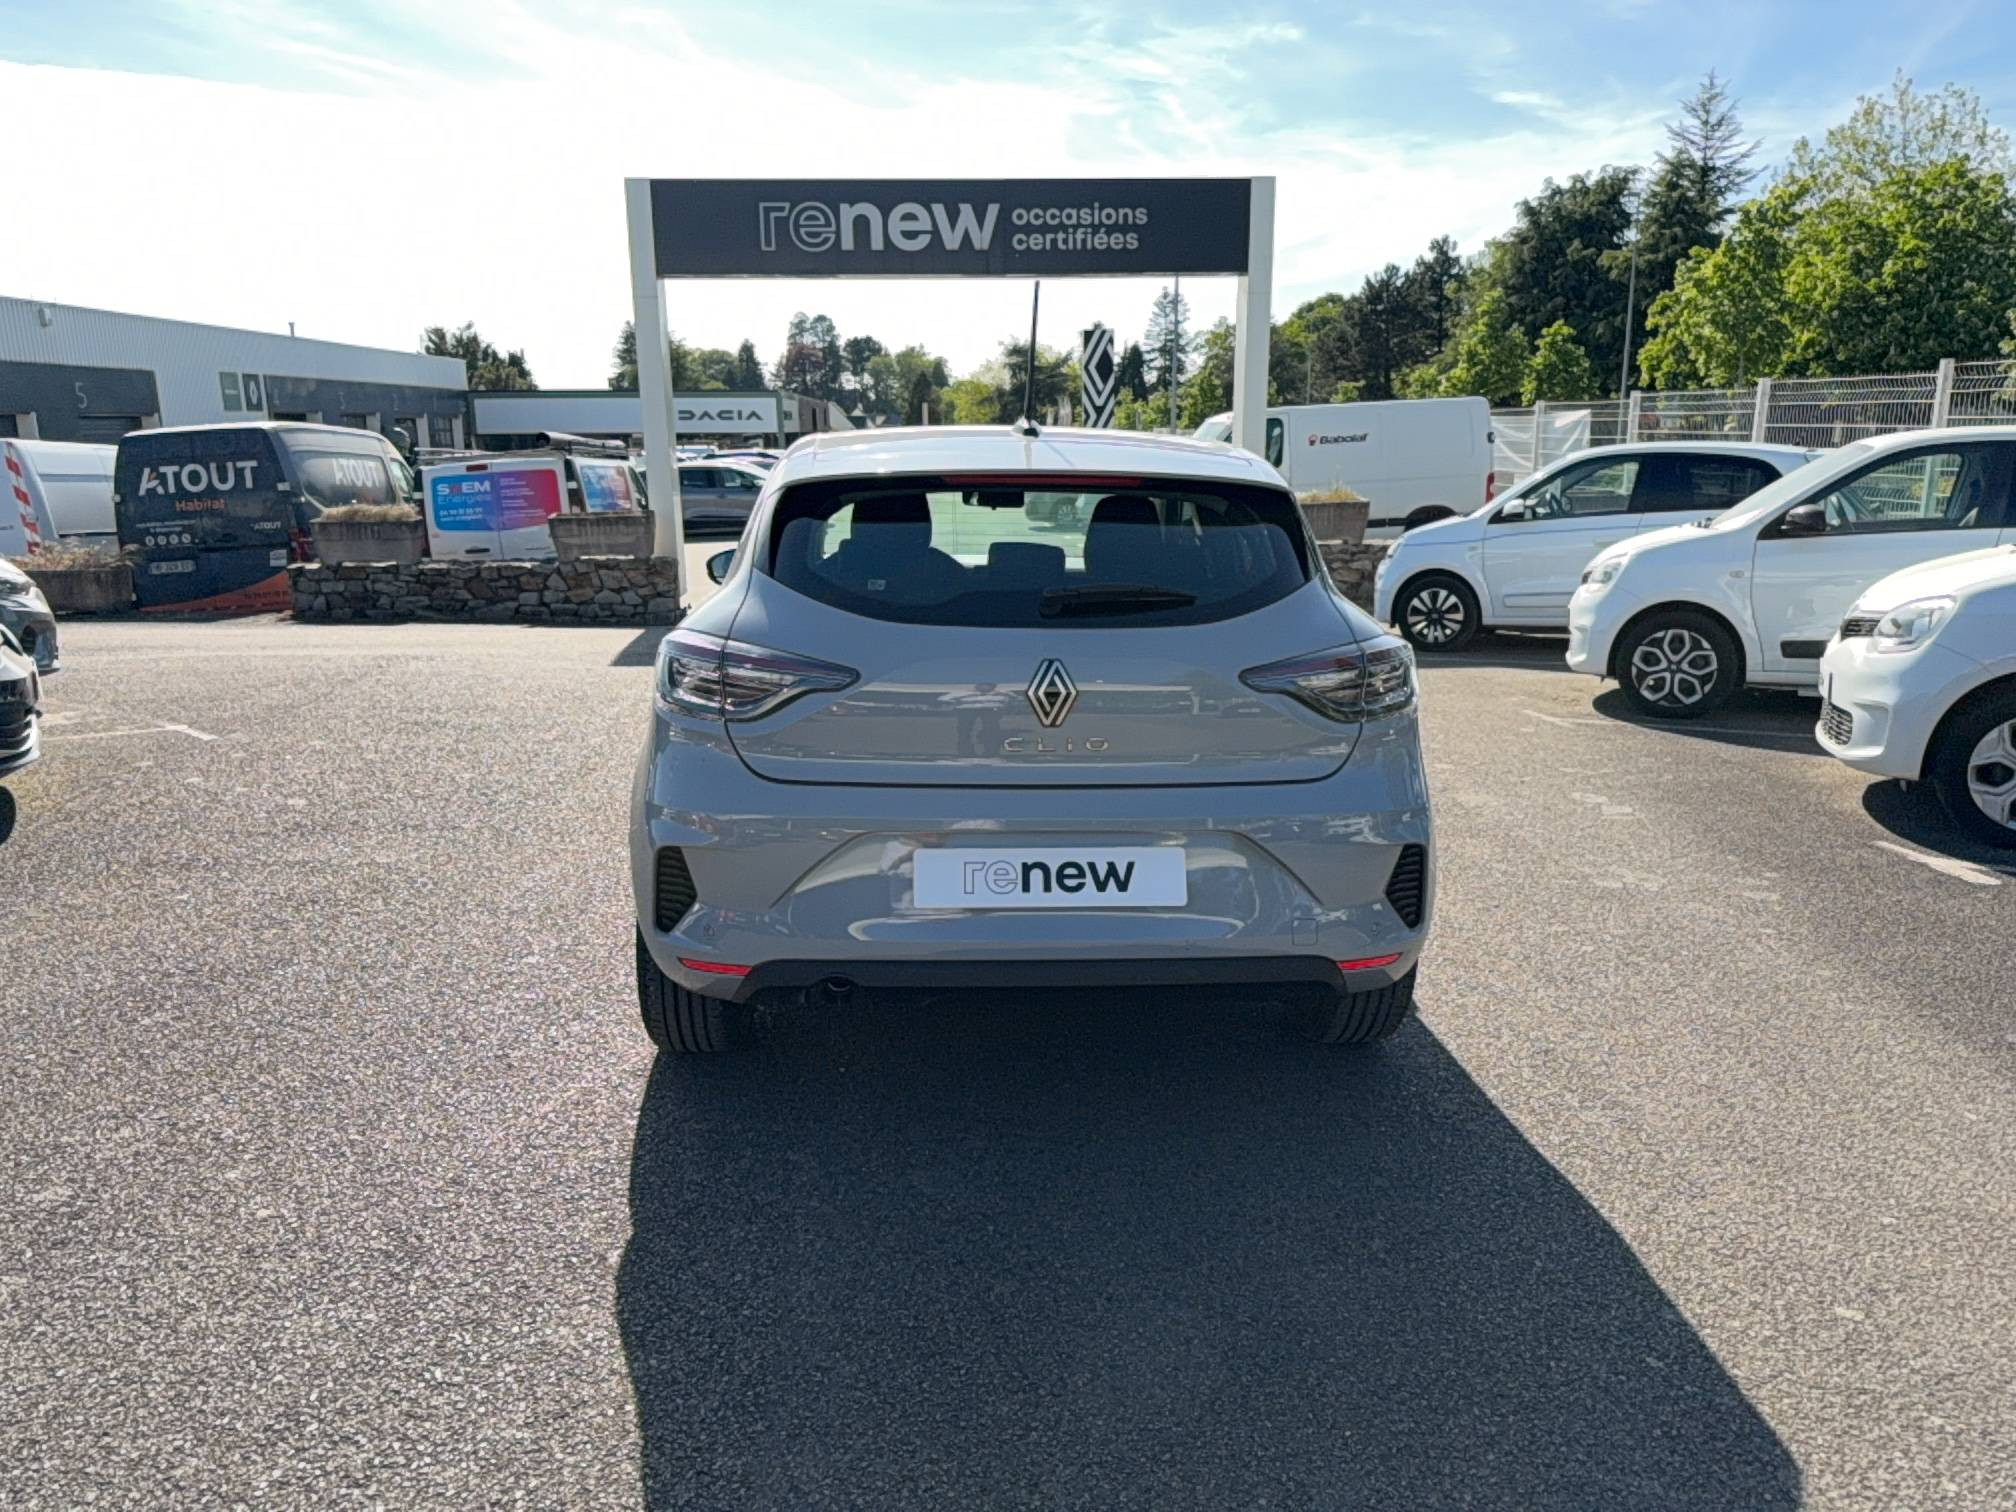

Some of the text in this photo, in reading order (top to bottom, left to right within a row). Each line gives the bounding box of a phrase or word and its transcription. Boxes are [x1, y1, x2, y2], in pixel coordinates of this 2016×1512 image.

[758, 201, 1001, 252] renew
[1011, 202, 1149, 226] occasions
[1011, 227, 1140, 251] certifiées
[75, 381, 88, 409] 5
[677, 409, 764, 421] DACIA
[138, 459, 259, 497] ATOUT
[331, 457, 380, 488] ATOUT
[175, 497, 226, 512] Habitat
[1003, 737, 1109, 752] CLIO
[962, 859, 1136, 895] renew
